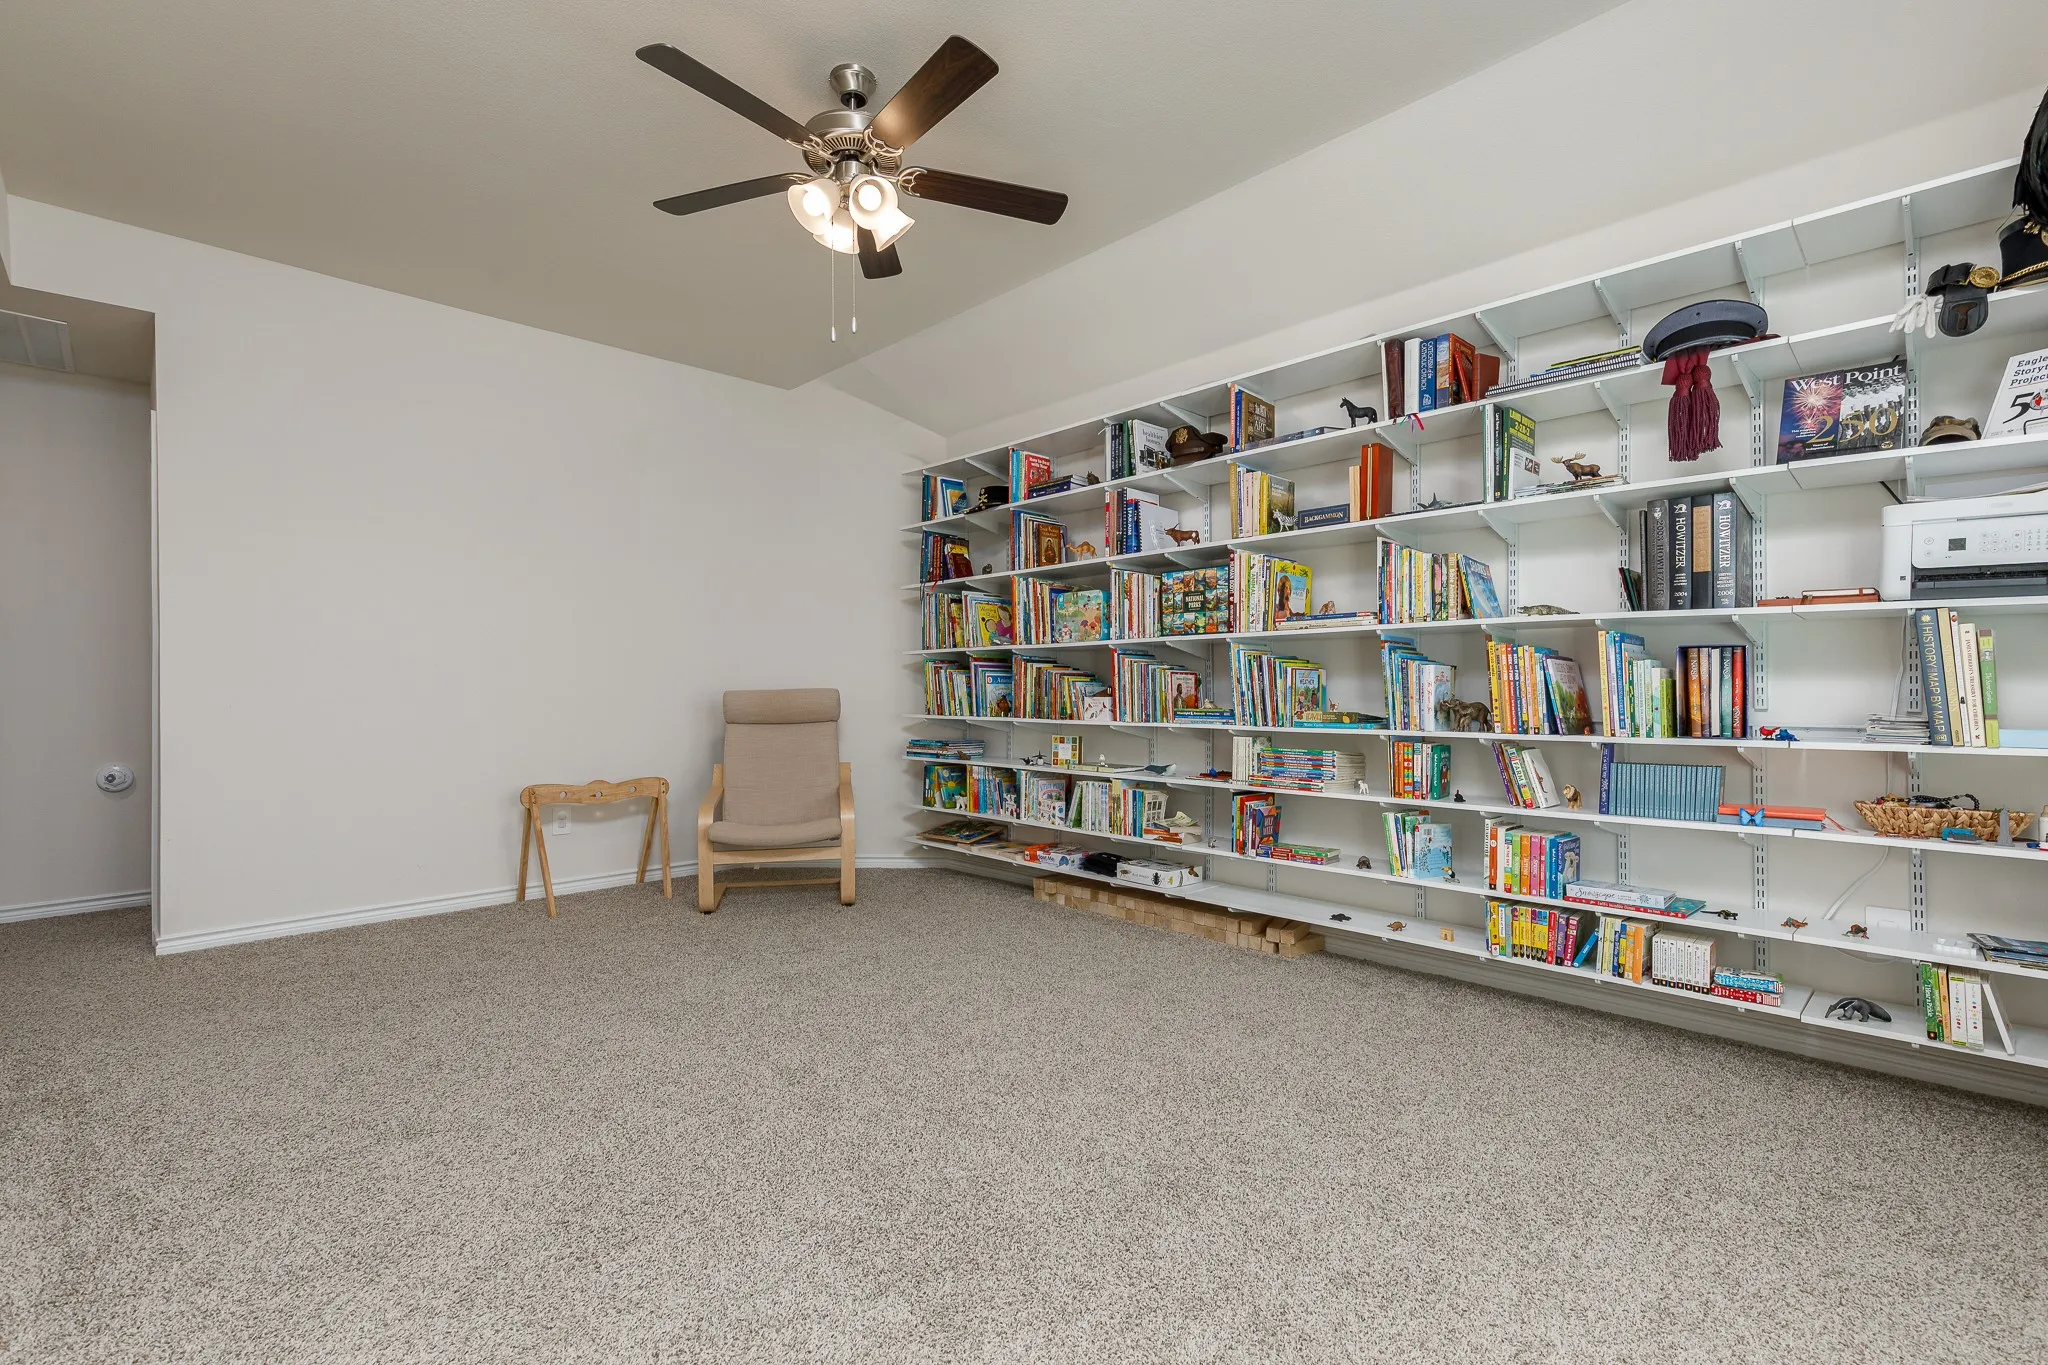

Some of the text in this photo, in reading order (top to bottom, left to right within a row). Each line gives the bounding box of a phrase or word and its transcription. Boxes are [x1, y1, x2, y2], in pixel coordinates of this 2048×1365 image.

[1791, 374, 1840, 392] West
[1844, 364, 1902, 384] Point
[1807, 408, 1898, 444] 250
[1304, 512, 1344, 523] BACKGAMMON
[1675, 518, 1686, 568] HOWITZER
[1719, 515, 1731, 568] HOWITZER
[1657, 544, 1665, 596] HOWITZER
[1922, 626, 1937, 667] HISTORY
[1928, 672, 1940, 694] MAP
[1930, 696, 1942, 708] BY
[1934, 710, 1945, 732] MAP
[1513, 762, 1524, 782] FARM
